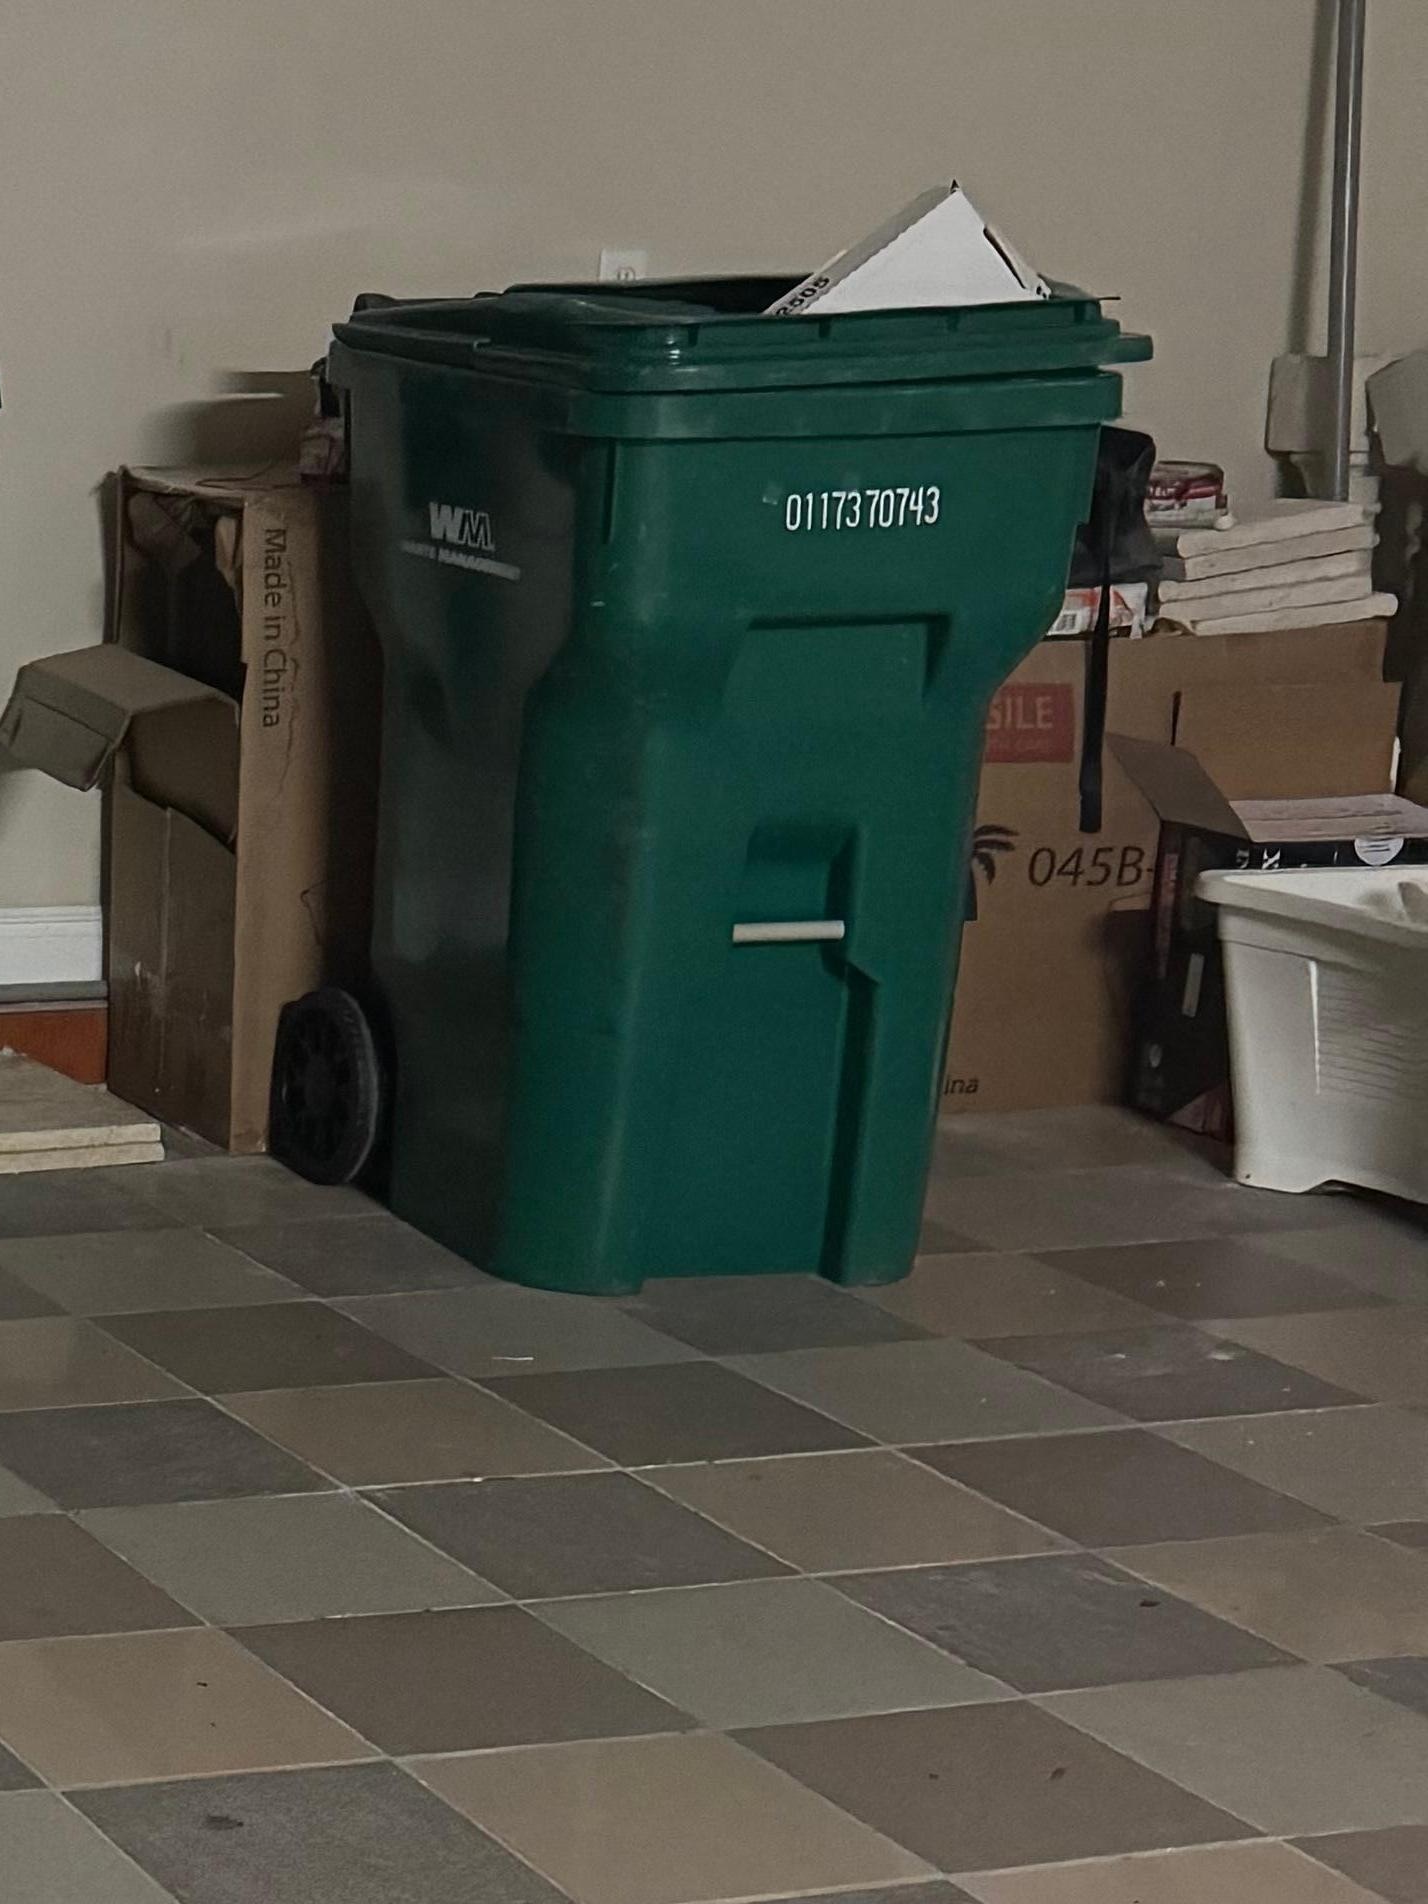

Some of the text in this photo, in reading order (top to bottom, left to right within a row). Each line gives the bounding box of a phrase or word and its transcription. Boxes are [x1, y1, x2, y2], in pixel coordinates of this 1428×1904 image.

[429, 501, 495, 552] WM
[785, 485, 940, 531] 0117370743
[262, 528, 288, 728] Made in China
